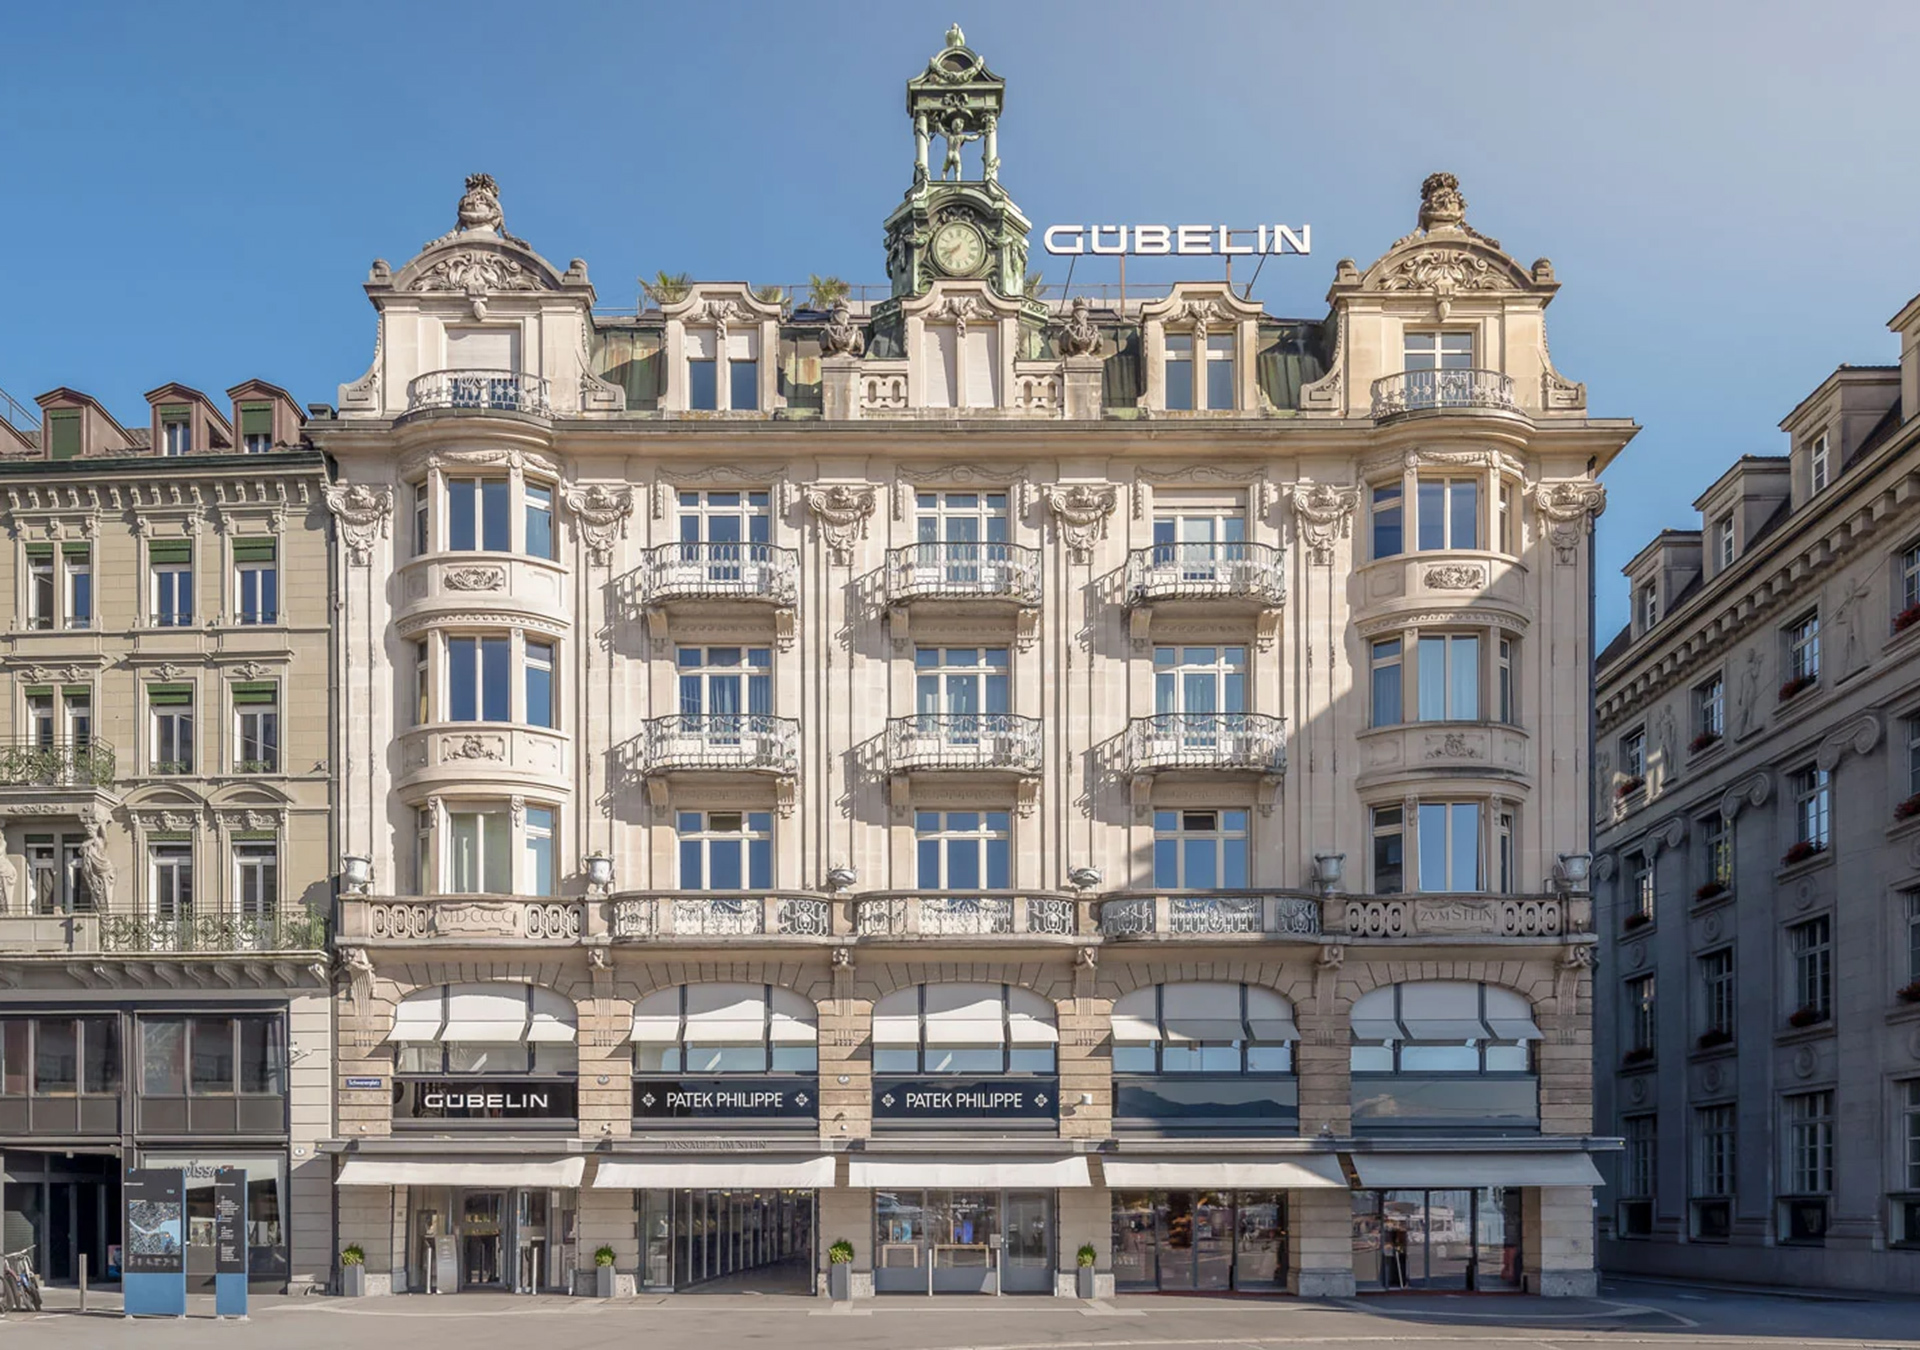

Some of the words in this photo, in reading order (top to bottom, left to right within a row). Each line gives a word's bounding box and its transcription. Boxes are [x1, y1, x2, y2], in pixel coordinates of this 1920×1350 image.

[1043, 224, 1311, 255] GÜBELIN
[1451, 908, 1493, 921] STEIN
[424, 1093, 549, 1109] GÜBELIN
[666, 1092, 713, 1108] PATEK
[716, 1092, 783, 1108] PHILIPPE
[906, 1092, 953, 1109] PATEK
[956, 1092, 1023, 1109] PHILIPPE
[738, 1140, 767, 1150] STEIN
